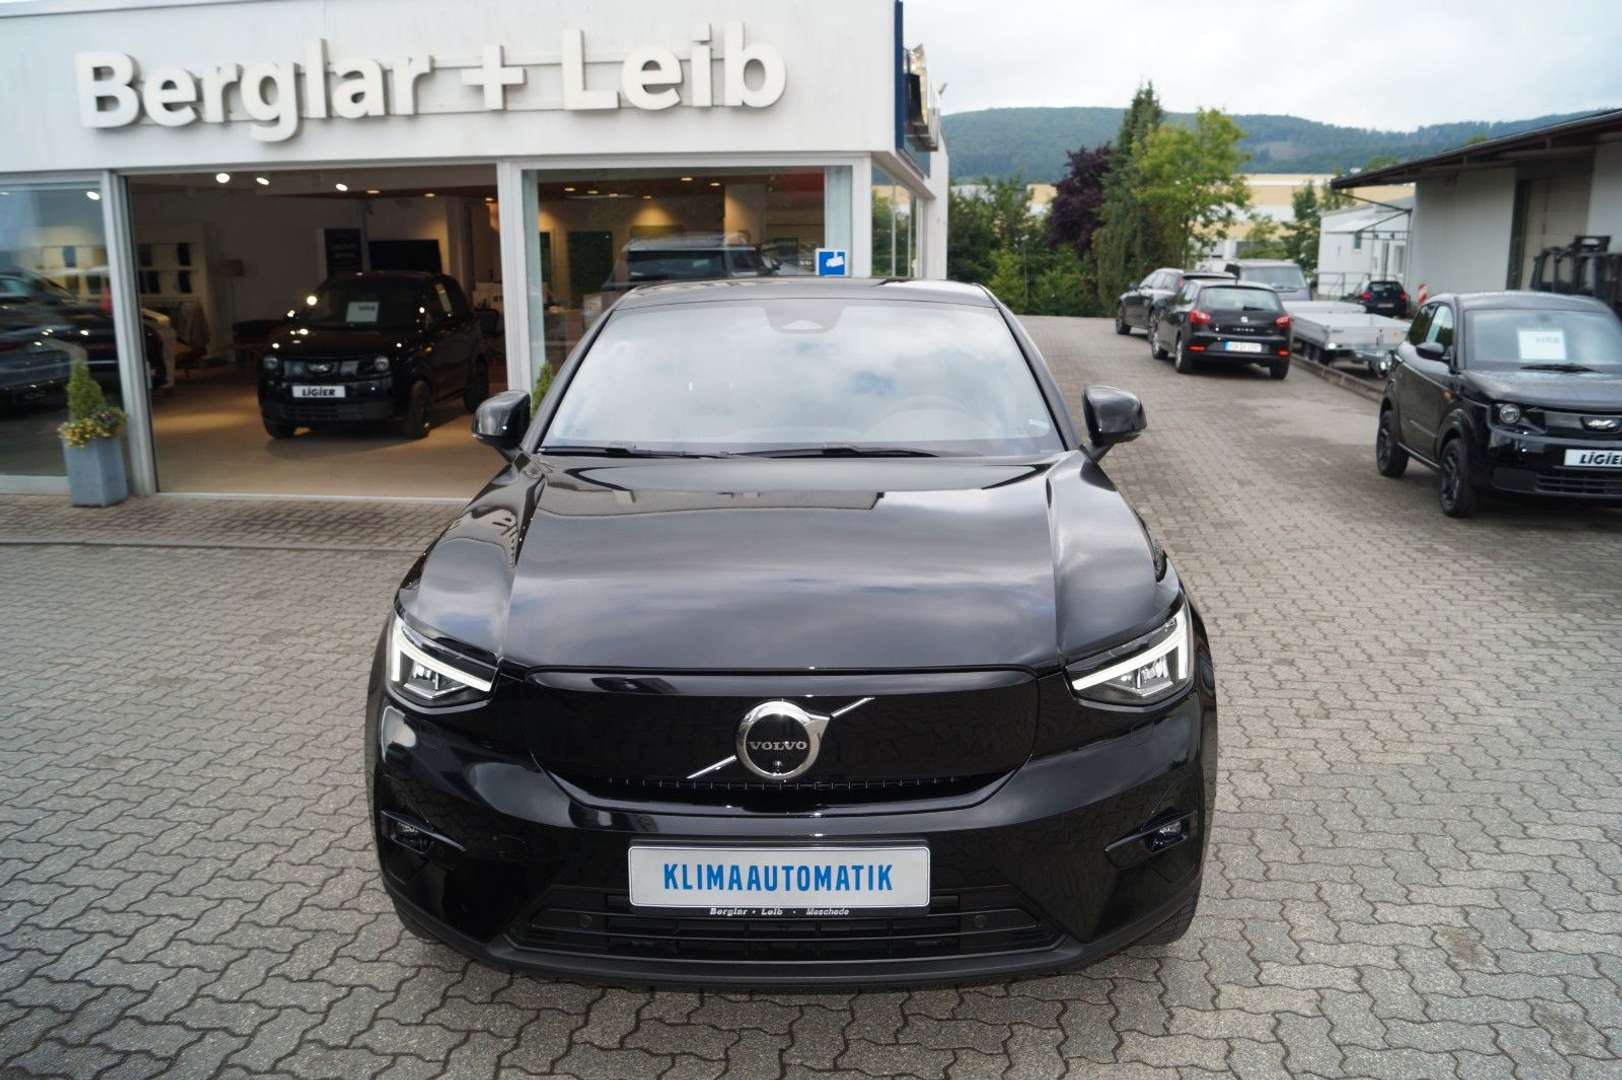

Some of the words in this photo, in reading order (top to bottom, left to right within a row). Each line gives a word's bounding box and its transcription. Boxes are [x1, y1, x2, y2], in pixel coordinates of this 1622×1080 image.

[77, 37, 432, 143] Berglar
[465, 44, 526, 109] +
[562, 23, 788, 110] Leib
[1579, 452, 1622, 465] LIGIE
[750, 740, 808, 751] VOLVO
[664, 864, 893, 892] KLIMAAUTOMATIK
